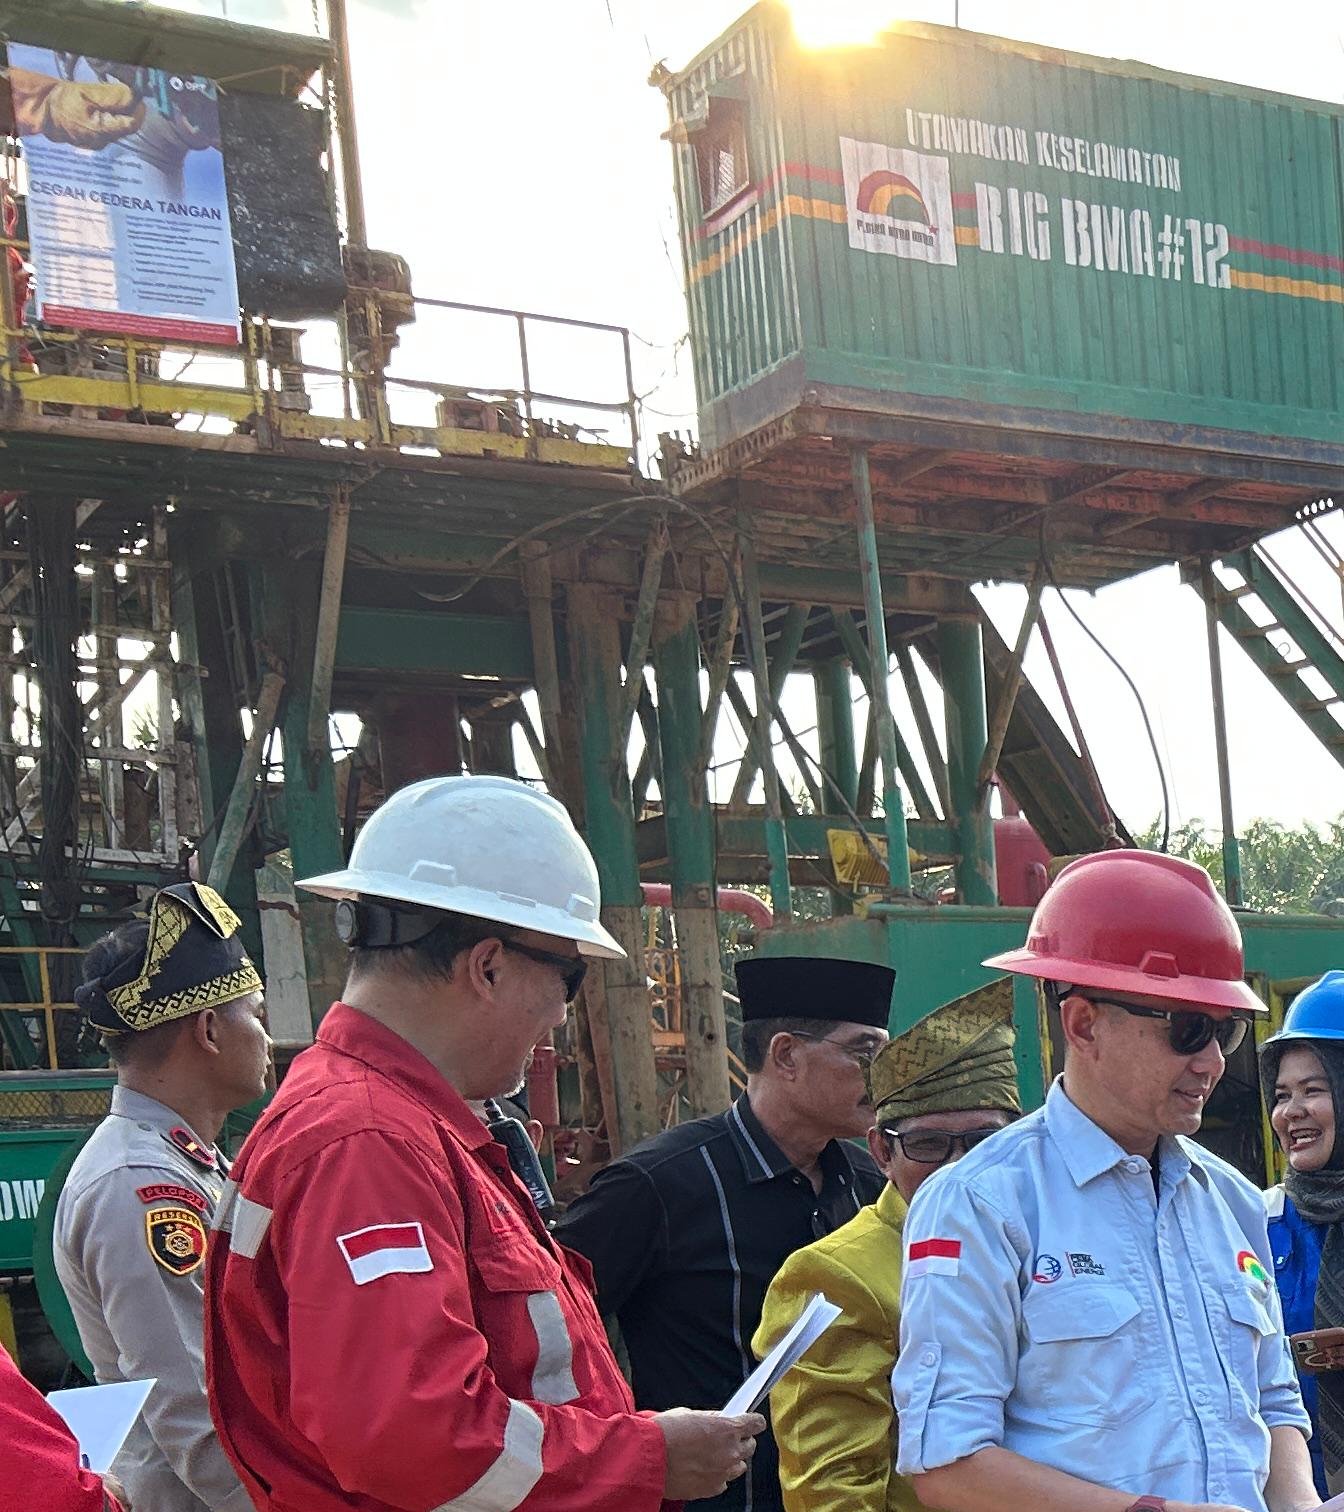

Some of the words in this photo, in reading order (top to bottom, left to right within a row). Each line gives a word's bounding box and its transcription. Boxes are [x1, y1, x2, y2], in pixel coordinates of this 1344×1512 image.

[906, 109, 1029, 164] UTAMAKAN
[1035, 131, 1181, 191] KESELAMATAN
[30, 179, 85, 200] CEGAH
[89, 190, 153, 211] CEDERA
[158, 201, 222, 221] TANGAN
[975, 182, 1051, 260] RIG
[1061, 198, 1231, 289] BMA#12
